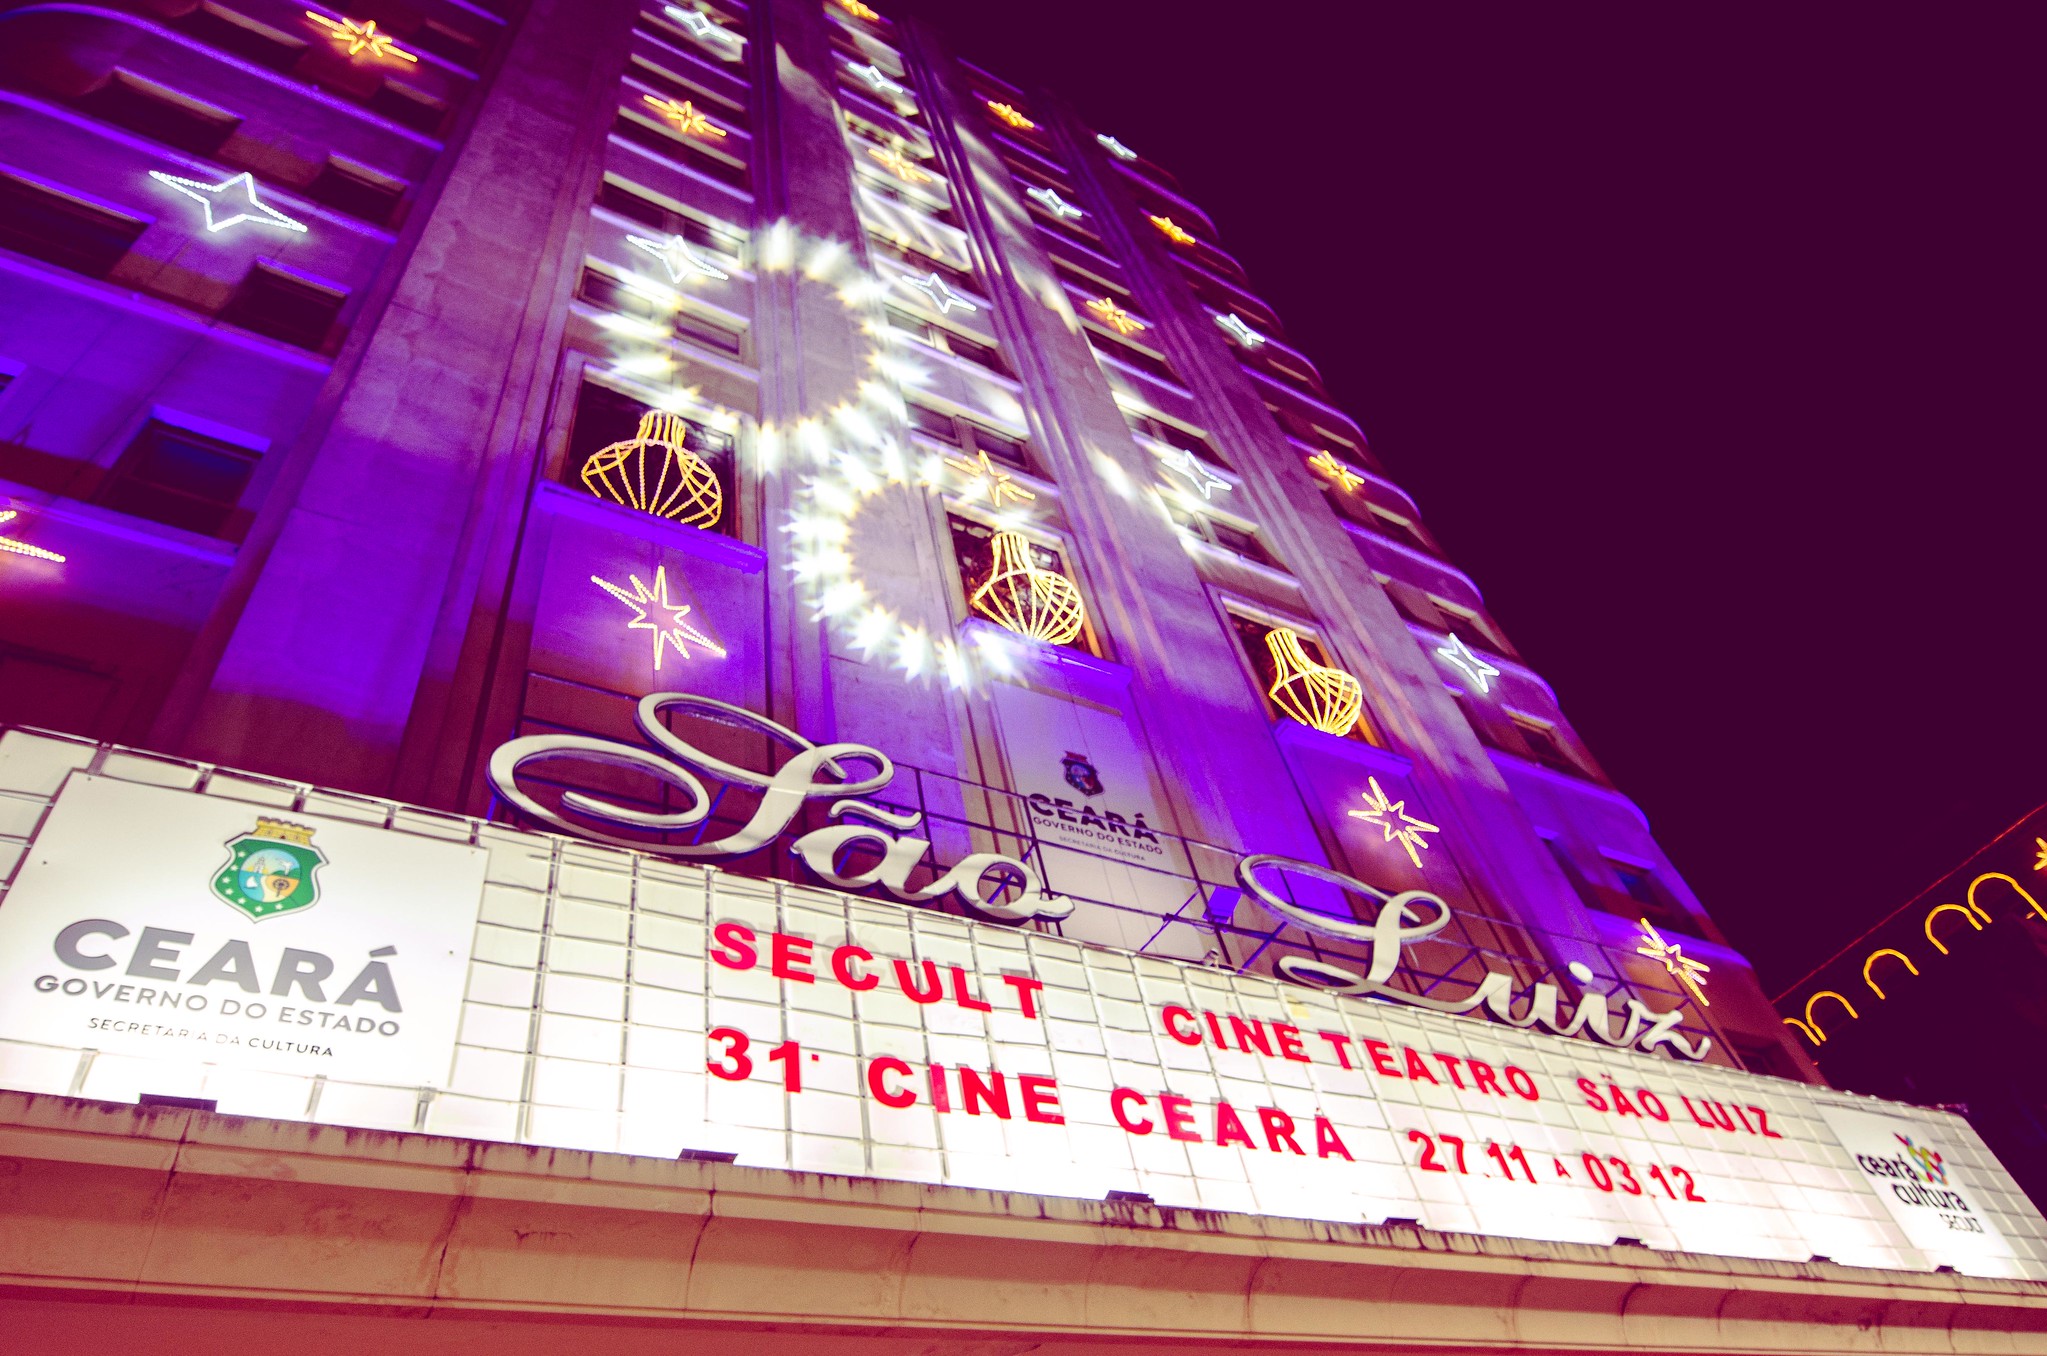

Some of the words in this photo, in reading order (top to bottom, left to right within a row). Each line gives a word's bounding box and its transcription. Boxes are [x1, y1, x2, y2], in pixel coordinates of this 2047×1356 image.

[1029, 793, 1159, 844] CEARÁ
[1033, 816, 1094, 838] GOVERNO
[1097, 831, 1115, 843] DO
[1117, 837, 1163, 855] ESTADO
[487, 692, 1075, 924] São
[1237, 854, 1711, 1060] Luiz
[54, 918, 403, 1013] CEARÁ
[709, 922, 1043, 1020] SECULT
[34, 974, 209, 1012] GOVERNO
[220, 998, 268, 1020] DO
[278, 1006, 401, 1037] ESTADO
[215, 1033, 241, 1046] DA
[248, 1037, 334, 1057] CULTURA
[1162, 1005, 1312, 1063] CINE
[1318, 1031, 1540, 1102] TEATRO
[1679, 1095, 1784, 1139] LUIZ
[867, 1056, 1066, 1126] CINE
[1408, 1129, 1538, 1185] 27.11
[1581, 1151, 1707, 1203] 03.12
[1855, 1152, 1920, 1182] ceará
[1891, 1182, 1971, 1213] cultura
